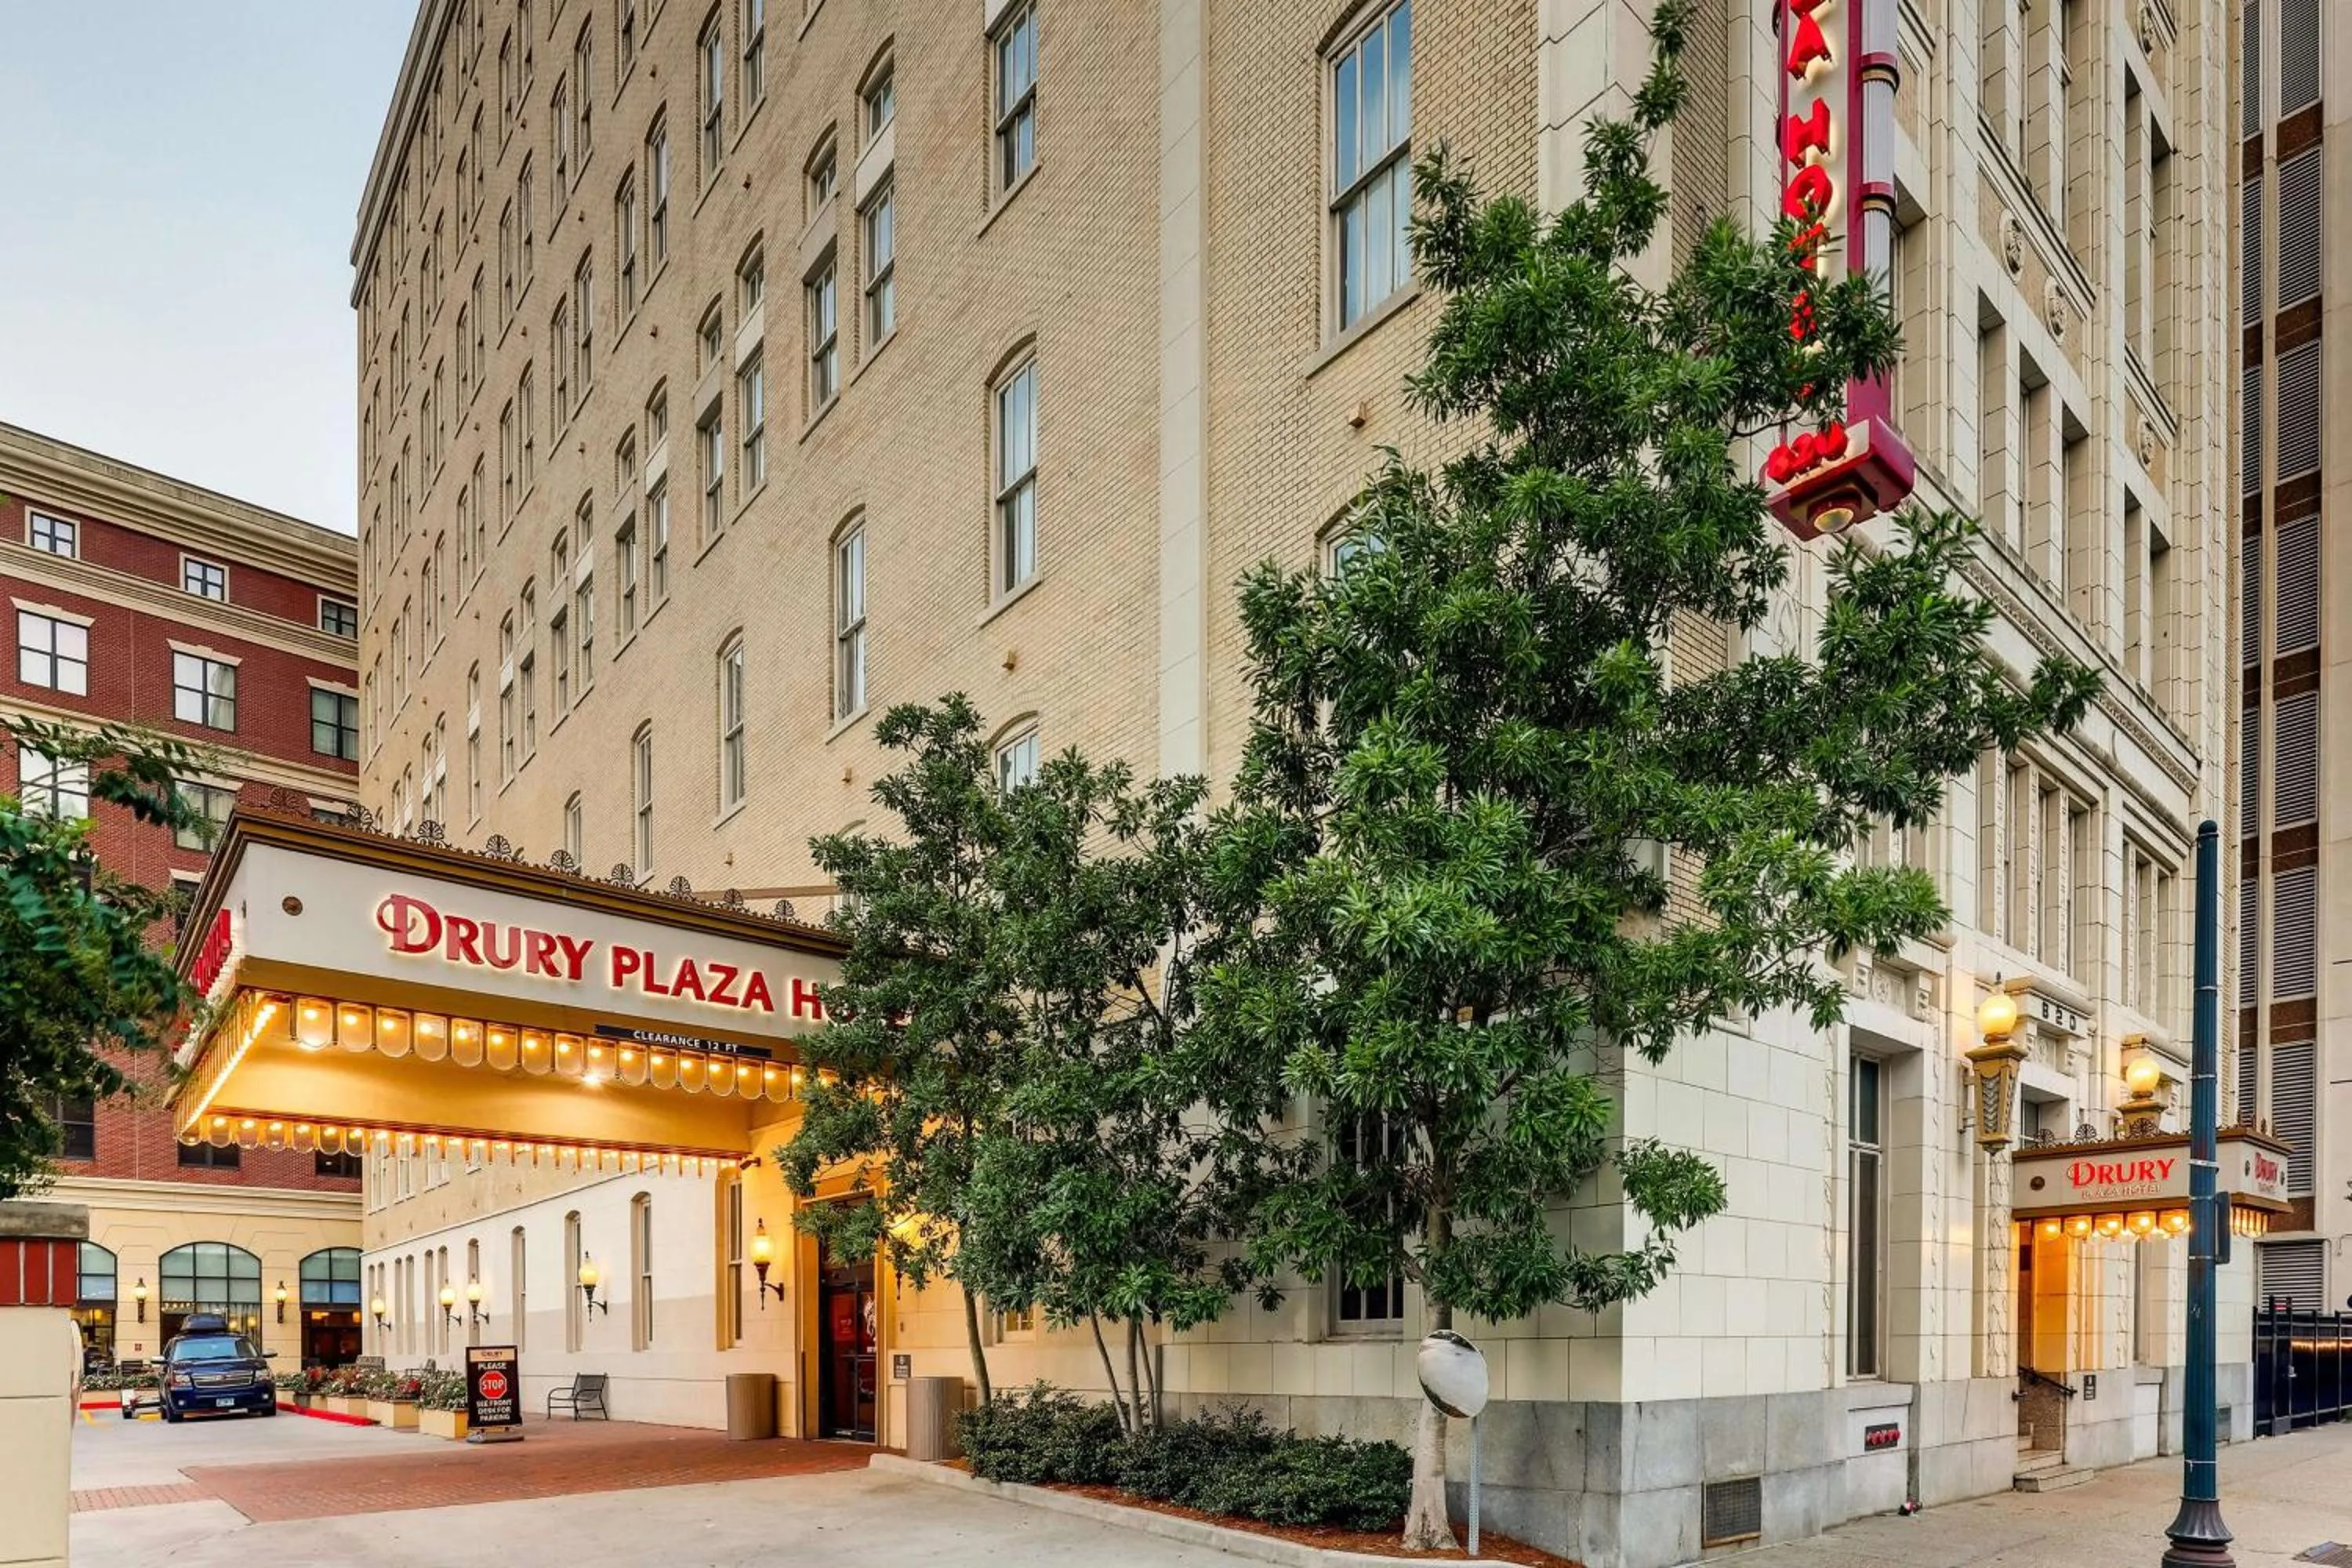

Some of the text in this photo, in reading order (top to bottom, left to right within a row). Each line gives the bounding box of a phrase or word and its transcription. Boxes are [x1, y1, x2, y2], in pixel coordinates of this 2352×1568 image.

[376, 894, 594, 981] DRURY
[612, 946, 775, 1012] PLAZA
[2042, 1001, 2076, 1030] 820
[633, 1030, 739, 1053] CLEARANCE 12 FT
[2067, 1157, 2175, 1189] DRURY
[478, 1362, 507, 1370] PLEASE
[482, 1379, 504, 1391] STOP
